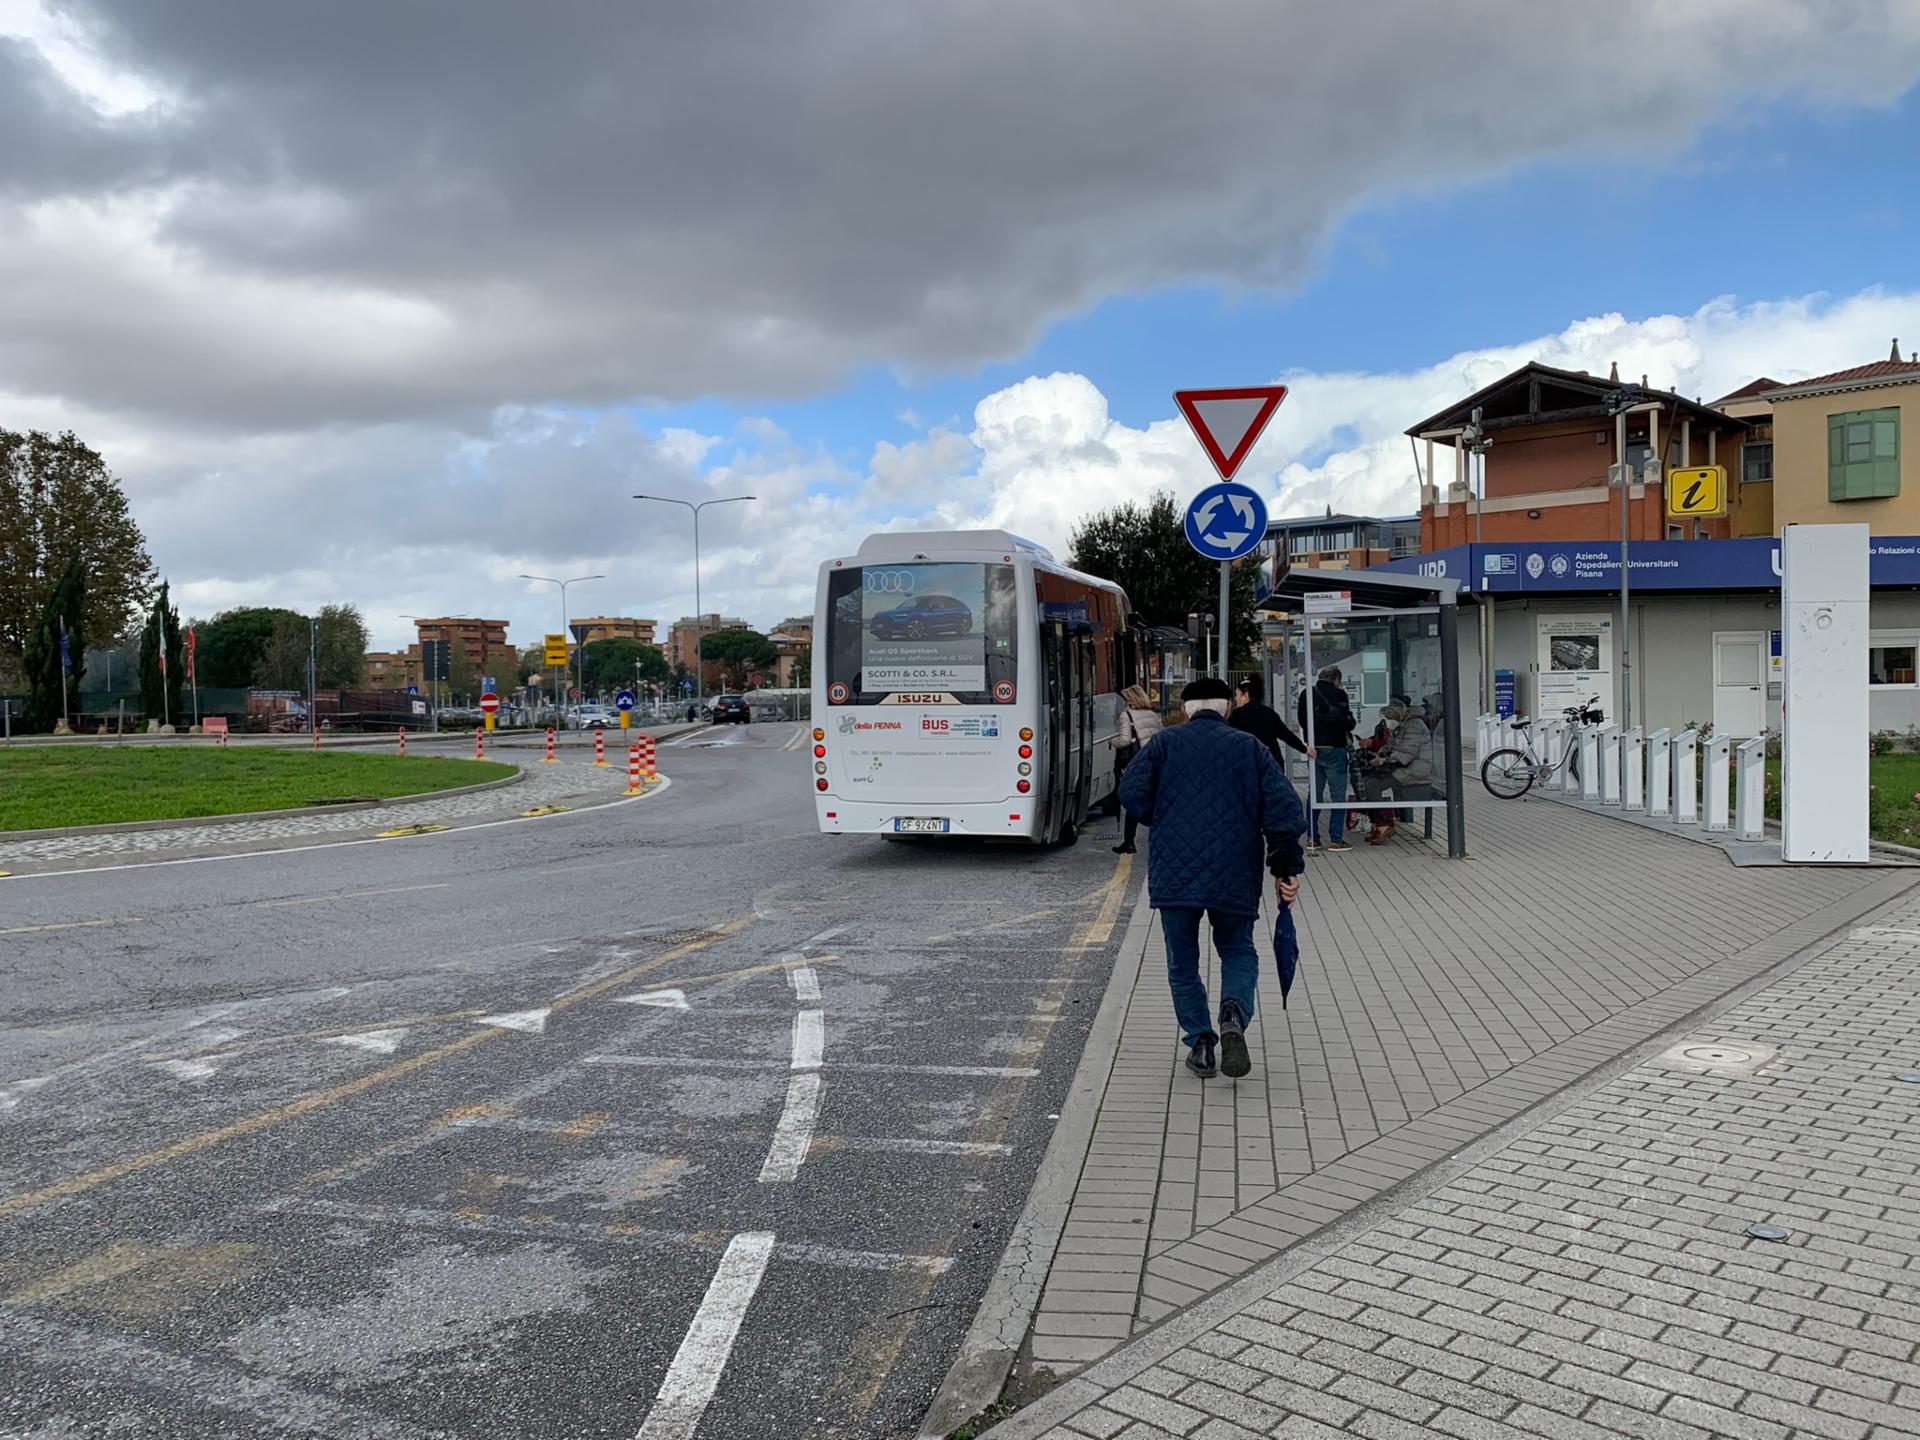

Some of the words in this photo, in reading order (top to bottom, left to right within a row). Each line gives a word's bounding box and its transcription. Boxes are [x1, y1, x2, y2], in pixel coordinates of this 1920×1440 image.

[1878, 546, 1915, 554] Relazioni
[1575, 552, 1608, 560] Azienda
[1627, 559, 1679, 568] Universitaria
[1575, 570, 1603, 578] Pisana
[868, 670, 901, 678] SCOTTI
[931, 669, 958, 678] S.R.L.
[833, 688, 844, 698] 80
[998, 687, 1011, 696] 100
[897, 694, 942, 703] ISUZU
[854, 721, 873, 730] della
[873, 721, 902, 730] PENNA
[922, 719, 949, 730] BUS
[915, 820, 942, 830] 924NT
